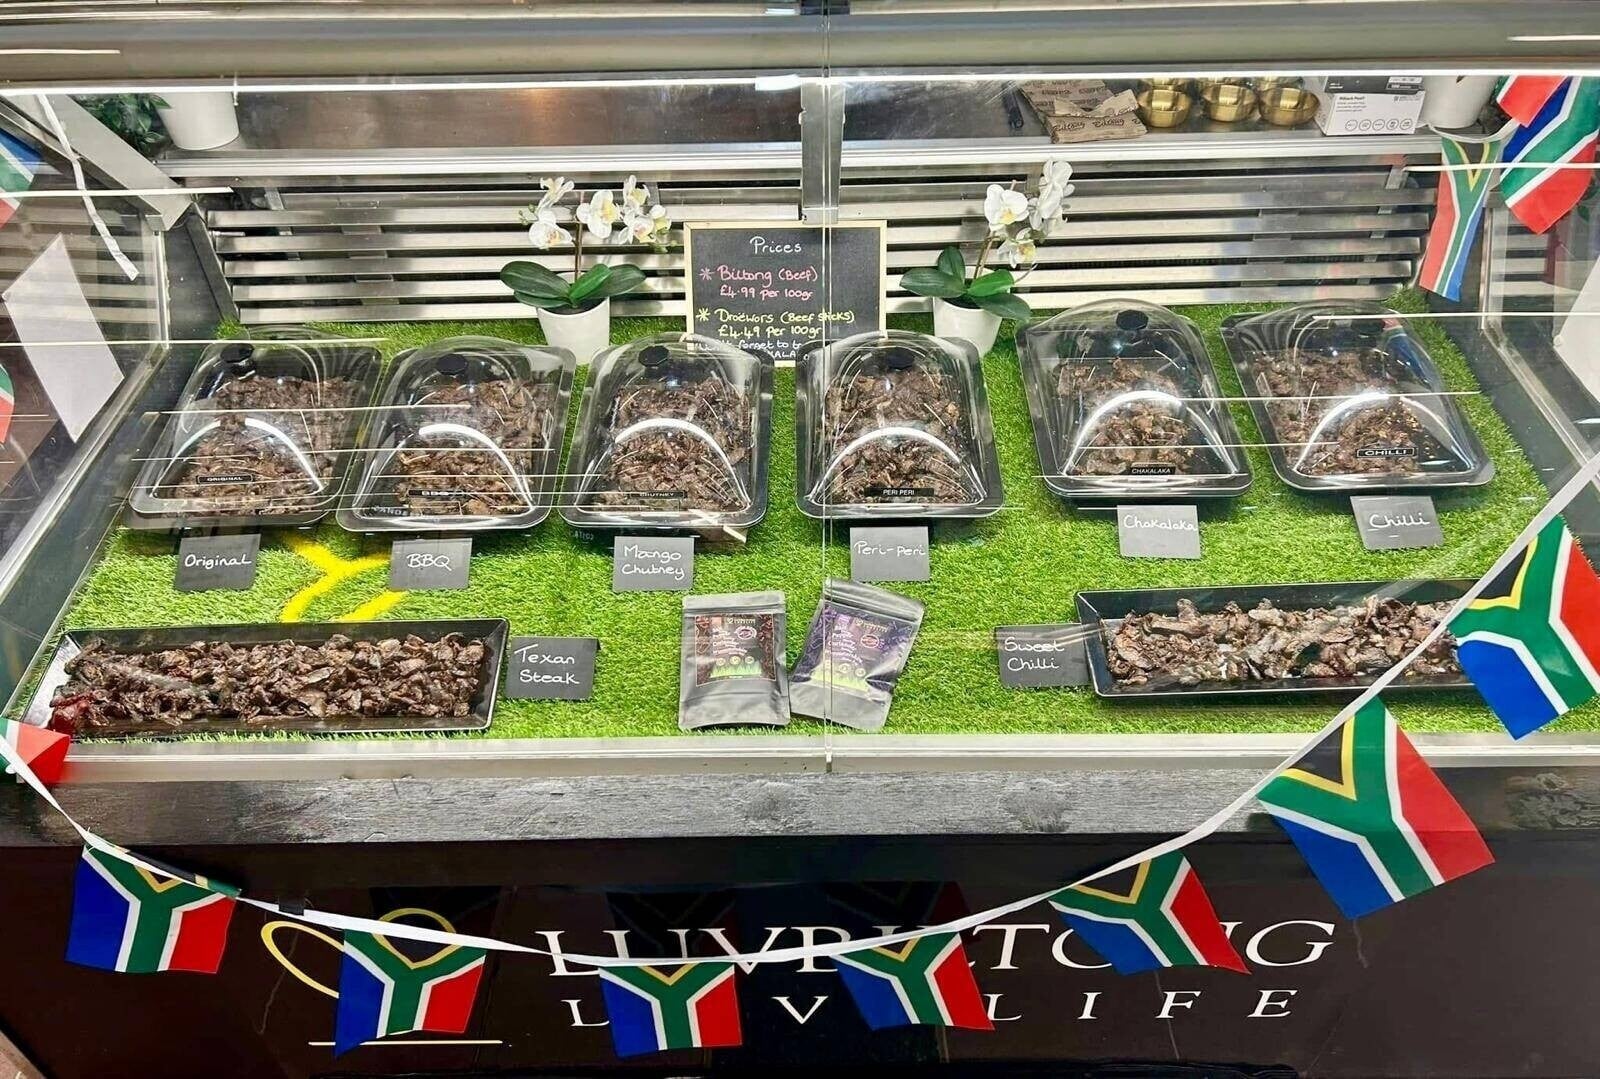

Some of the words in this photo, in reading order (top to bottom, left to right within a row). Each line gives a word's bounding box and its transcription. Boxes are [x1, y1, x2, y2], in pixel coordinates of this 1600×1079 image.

[749, 235, 803, 255] Prices
[716, 264, 772, 288] Biltong
[778, 265, 818, 283] (Beef)
[719, 284, 756, 299] £4.99
[759, 289, 780, 301] per
[784, 287, 814, 301] 100gr
[779, 310, 814, 324] (Beef
[717, 324, 761, 339] £4.49
[765, 326, 786, 338] per
[790, 325, 822, 340] 100gr
[738, 339, 775, 351] forget
[776, 340, 790, 350] to
[1364, 448, 1407, 456] CHILLI
[882, 488, 898, 496] PERI
[899, 488, 915, 496] PERI
[1368, 511, 1432, 529] Chilli
[184, 553, 253, 570] Original
[405, 553, 453, 572] BBQ
[623, 544, 682, 564] Mango
[621, 562, 686, 581] Chutney
[1004, 636, 1065, 653] Sweet
[513, 643, 576, 665] Texan
[1007, 656, 1060, 672] Chilli
[519, 668, 581, 685] Steak
